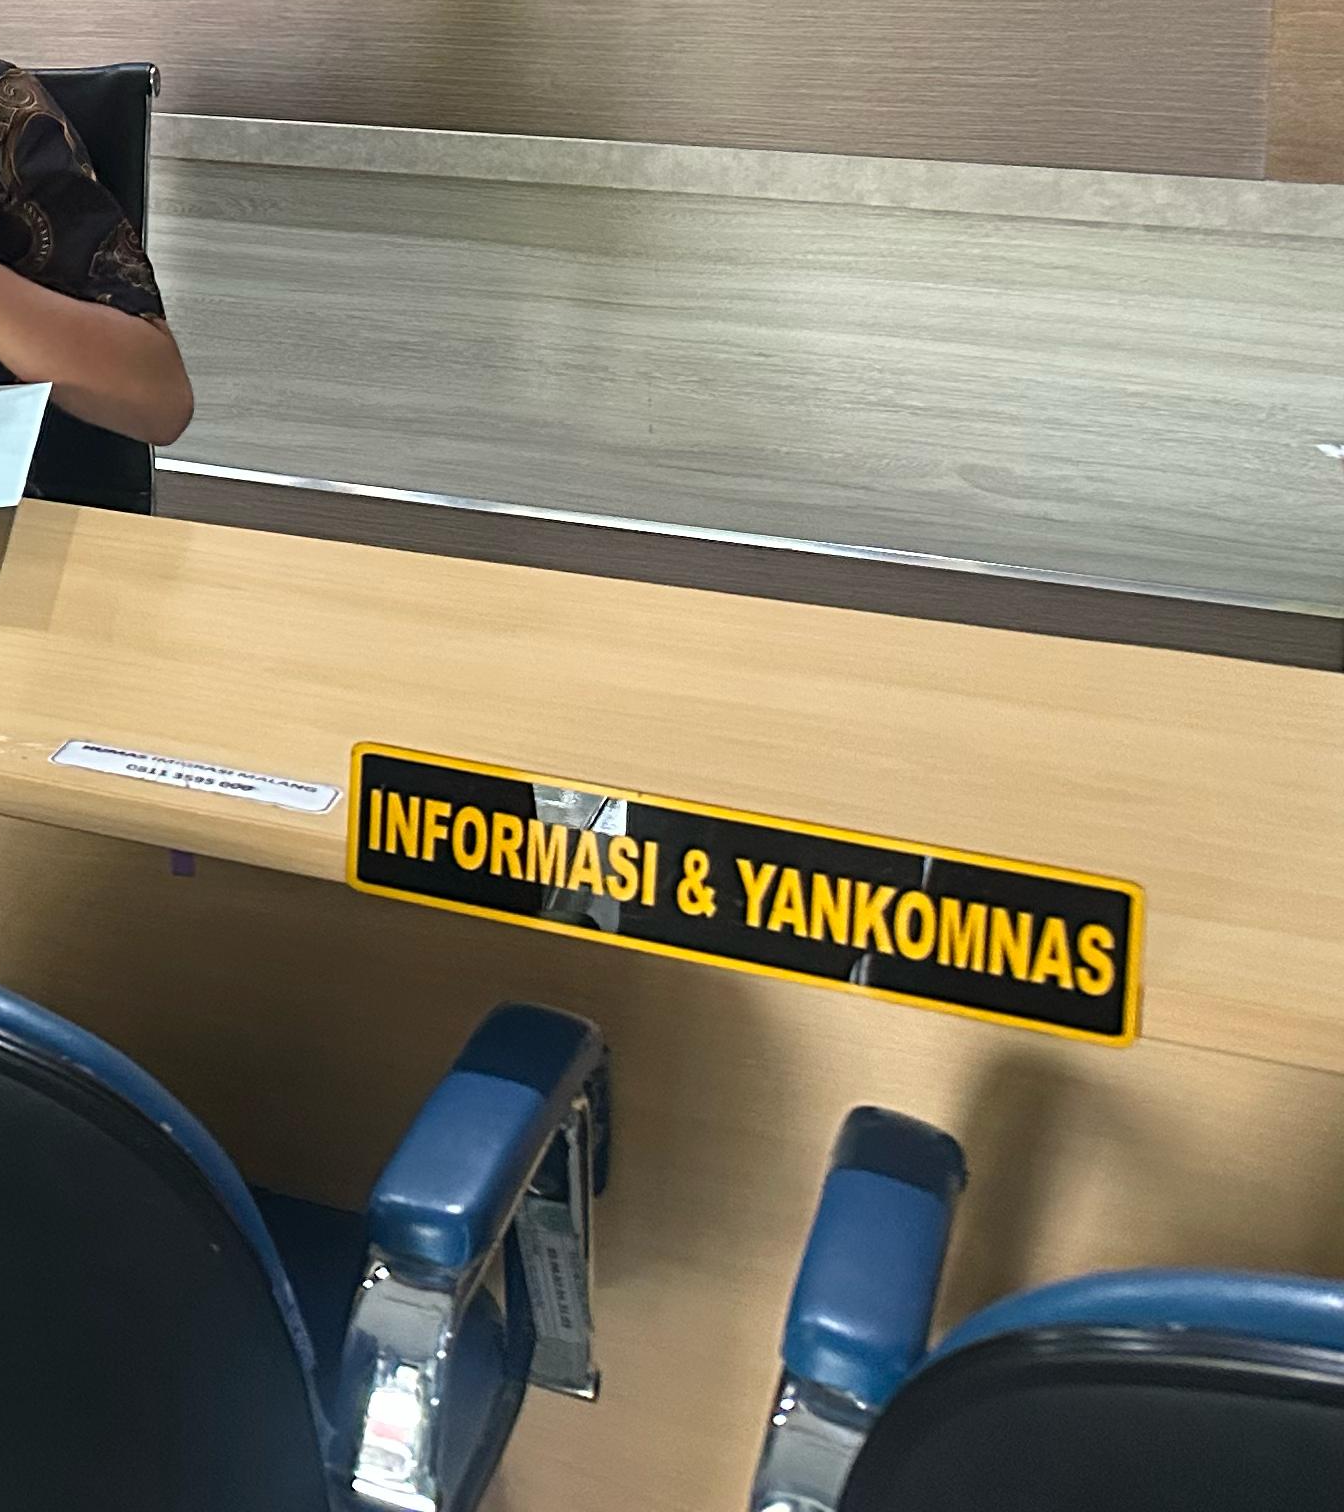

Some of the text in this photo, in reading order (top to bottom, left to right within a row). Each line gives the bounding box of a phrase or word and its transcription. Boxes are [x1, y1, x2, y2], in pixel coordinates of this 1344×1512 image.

[237, 771, 318, 793] MALANG
[367, 788, 1115, 997] INFORMASI & YANKOMNAS
